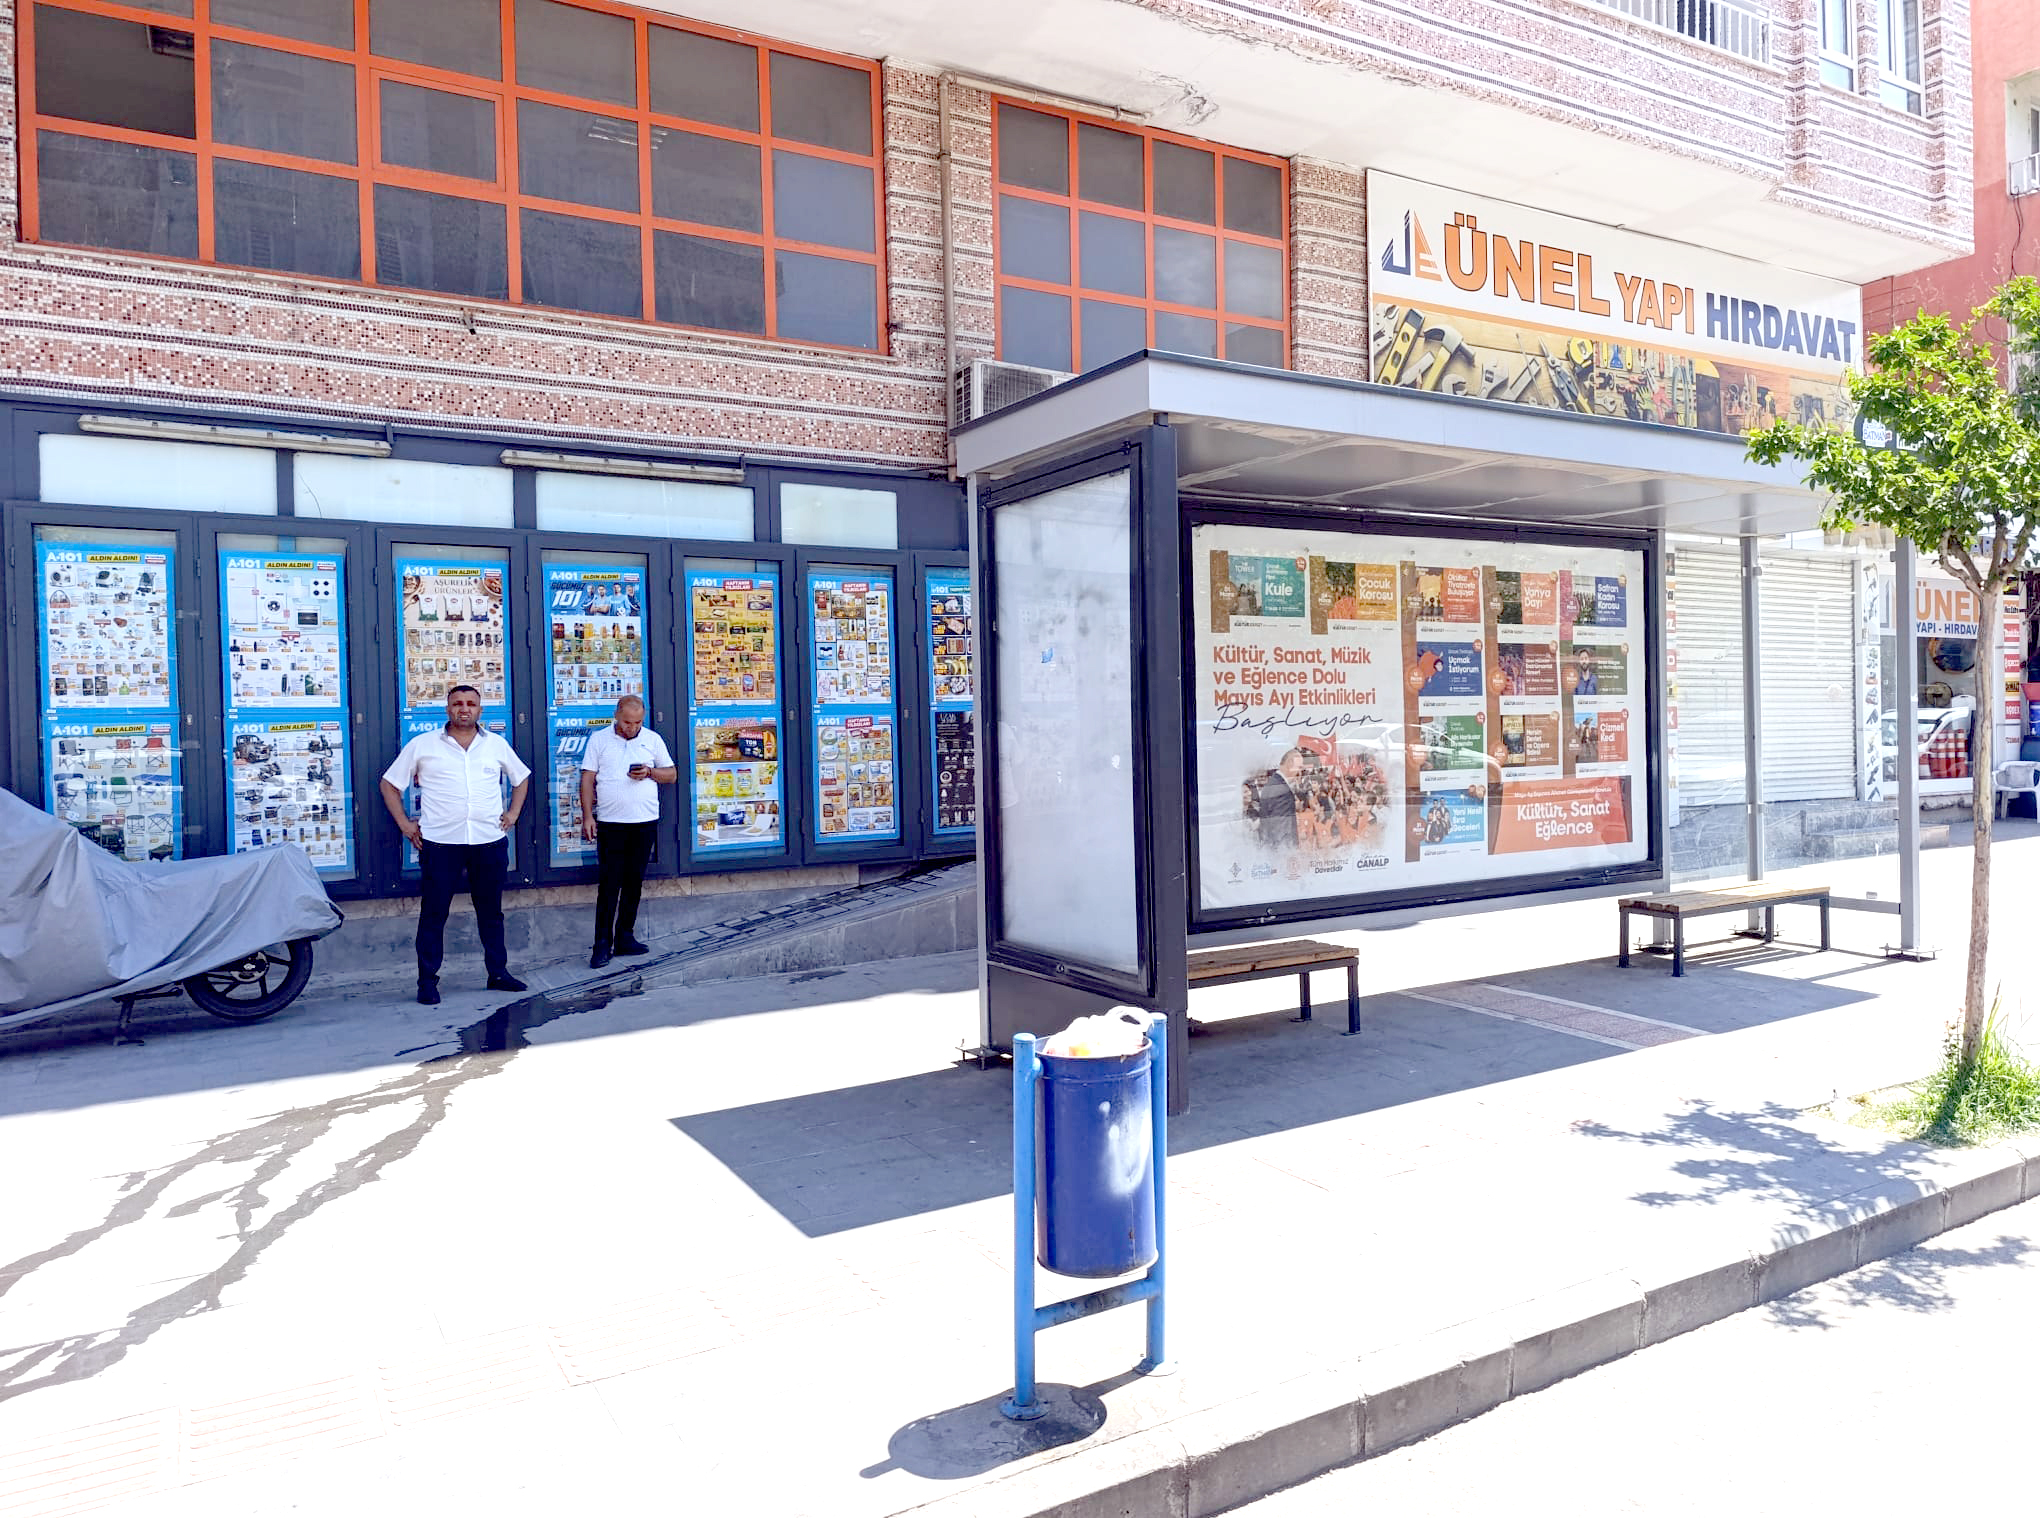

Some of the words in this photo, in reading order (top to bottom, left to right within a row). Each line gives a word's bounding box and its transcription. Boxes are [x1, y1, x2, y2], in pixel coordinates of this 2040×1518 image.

[1444, 212, 1611, 317] ÜNEL
[1614, 271, 1694, 335] YAPI
[1705, 292, 1856, 363] HIRDAVAT
[1265, 582, 1293, 596] Kule
[1359, 577, 1391, 590] Çocuk
[552, 590, 582, 608] 101
[1359, 589, 1394, 601] Korosu
[1524, 586, 1551, 598] Vanya
[1597, 600, 1620, 610] Korosu
[1917, 622, 1937, 634] YAPI
[1944, 623, 1978, 635] HIRDAV
[1213, 645, 1269, 666] Kültür,
[1273, 646, 1327, 666] Sanat,
[1331, 646, 1372, 664] Müzik
[1448, 656, 1471, 665] Uçmak
[1448, 663, 1480, 674] İstiyorum
[1213, 671, 1236, 684] ve
[1241, 667, 1308, 690] Eğlence
[1312, 668, 1346, 684] Dolu
[1214, 688, 1264, 709] Mayıs
[1268, 689, 1294, 709] Ayı
[1298, 687, 1376, 705] Etkinlikleri
[1212, 701, 1383, 739] Başlıyor
[557, 736, 588, 754] 101
[1600, 733, 1616, 743] Kedi
[1517, 802, 1567, 821] Kültür,
[1570, 800, 1610, 817] Sanat
[1535, 820, 1594, 840] Eğlence
[1357, 858, 1390, 869] CANALP
